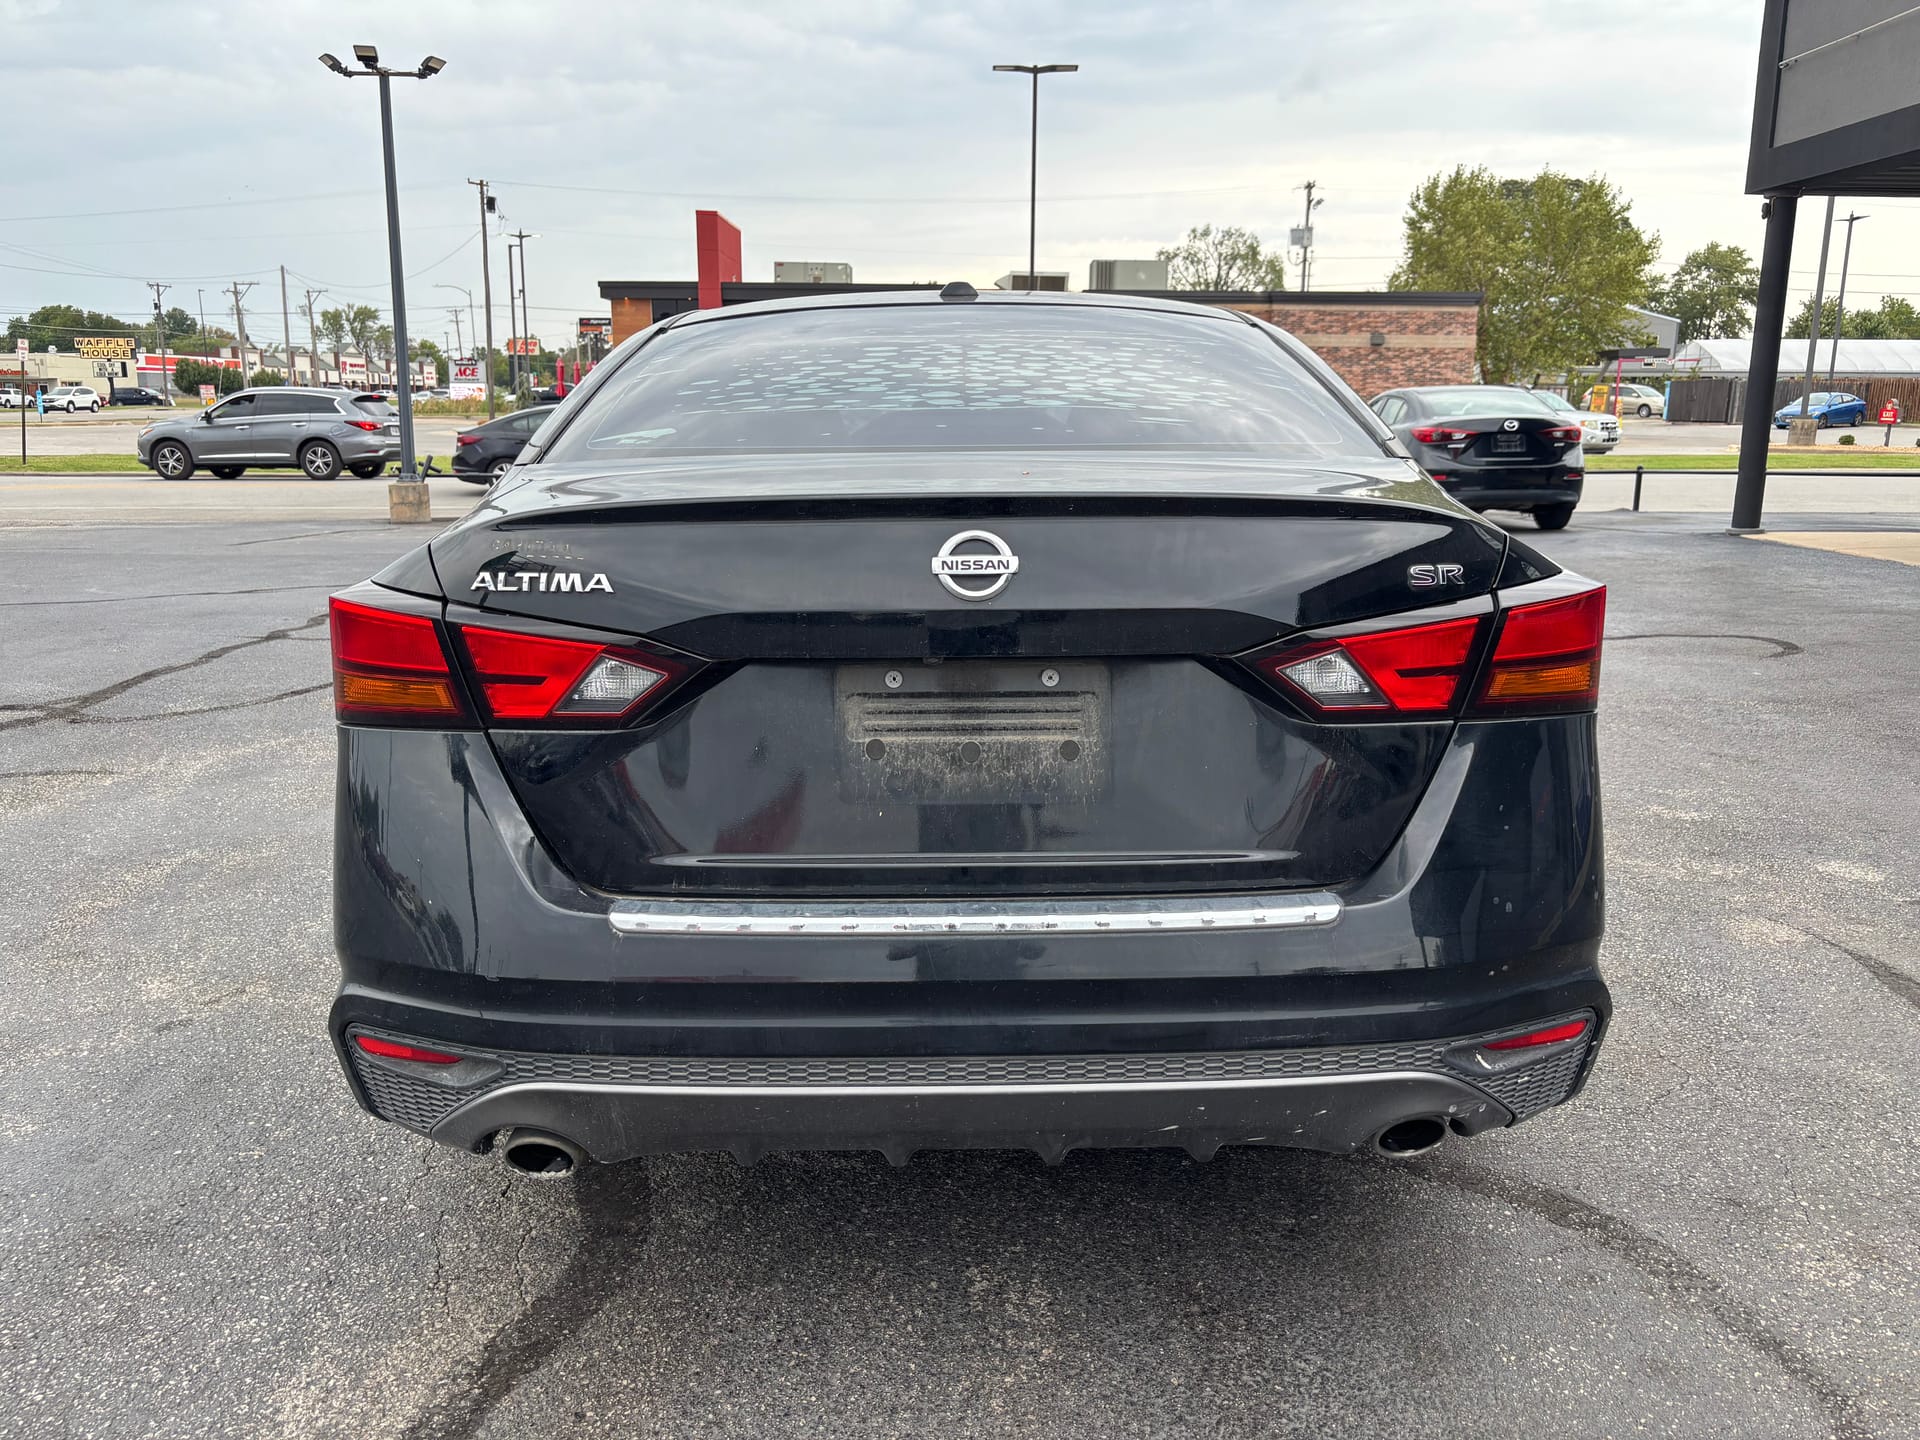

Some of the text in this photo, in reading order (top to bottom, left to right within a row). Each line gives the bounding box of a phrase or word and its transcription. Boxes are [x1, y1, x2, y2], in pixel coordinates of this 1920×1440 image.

[75, 339, 133, 347] WAFFLE
[455, 367, 478, 377] ACE
[941, 559, 1010, 571] NISSAN
[1409, 564, 1465, 586] SR
[470, 571, 614, 593] ALTIMA
